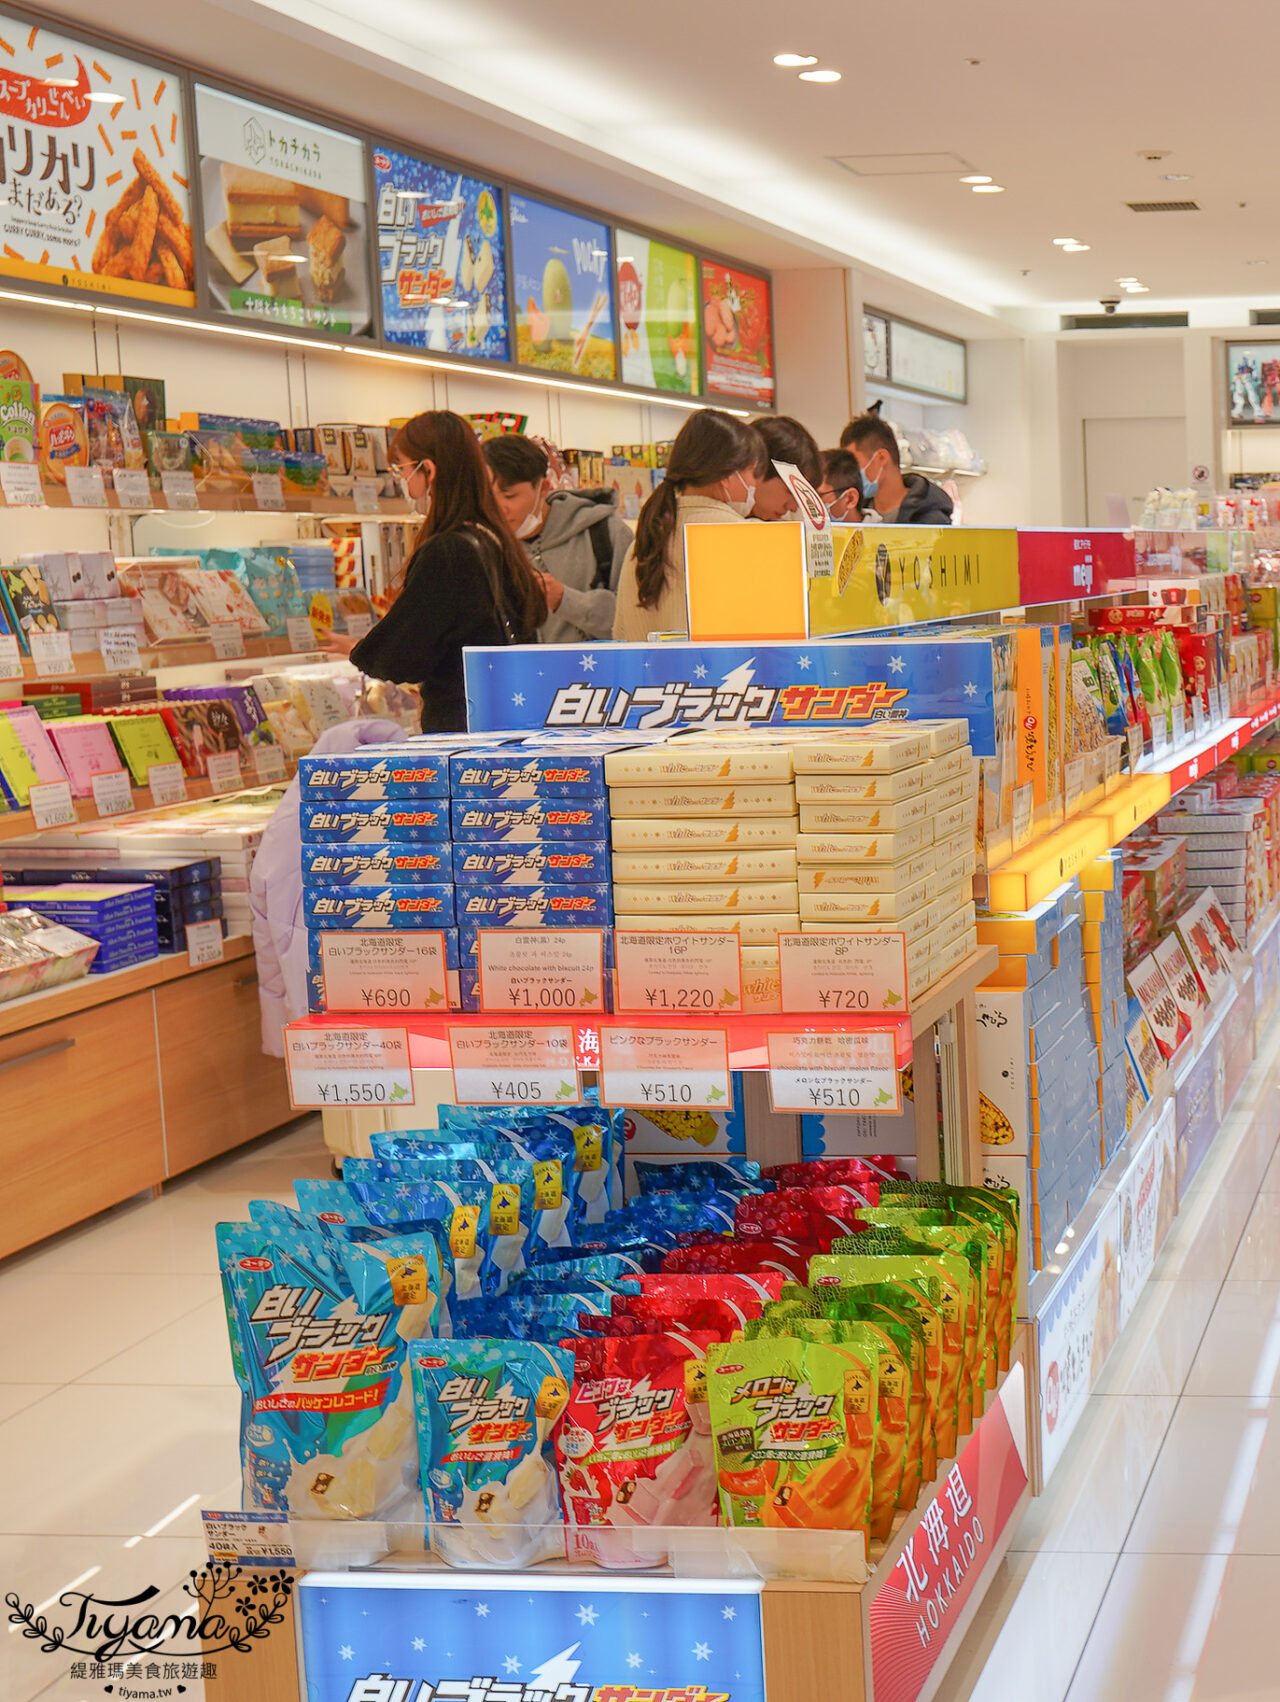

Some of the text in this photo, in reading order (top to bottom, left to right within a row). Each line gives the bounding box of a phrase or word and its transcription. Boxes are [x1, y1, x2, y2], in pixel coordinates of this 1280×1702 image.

[0, 125, 95, 195] リカリ
[378, 183, 418, 229] 白い
[378, 232, 445, 286] ブラック
[899, 554, 980, 591] YOSHIMI
[543, 681, 911, 728] 白いブラックサンダー
[360, 937, 404, 947] 北海道限定
[669, 945, 688, 955] 16P
[488, 964, 507, 972] White
[508, 964, 541, 972] chocolate
[542, 964, 557, 972] with
[558, 964, 581, 972] biscuit
[361, 988, 411, 1007] ¥690
[509, 988, 576, 1009] ¥1,000
[645, 988, 714, 1009] ¥1,220
[818, 988, 869, 1009] ¥720
[324, 1031, 368, 1041] 北海道限定
[488, 1030, 533, 1040] 北海道限定
[609, 1035, 718, 1047] ピンクなブラックサンダー
[318, 1083, 386, 1105] ¥1,550
[491, 1081, 542, 1101] ¥405
[641, 1083, 692, 1102] ¥510
[809, 1088, 861, 1107] ¥510
[250, 1284, 323, 1325] 白い
[264, 1312, 392, 1370] ブラック
[291, 1345, 397, 1383] サンダー
[438, 1375, 490, 1402] 白い
[730, 1376, 798, 1405] メロンな
[447, 1397, 530, 1434] ブラック
[595, 1388, 677, 1434] ブラック
[754, 1395, 836, 1430] ブラック
[467, 1420, 533, 1445] サンダー
[614, 1411, 685, 1445] サンダー
[770, 1417, 842, 1443] サンダー
[895, 1462, 974, 1603] 北海道
[261, 1547, 292, 1556] ¥1,550
[915, 1513, 985, 1649] HOKKAIDO
